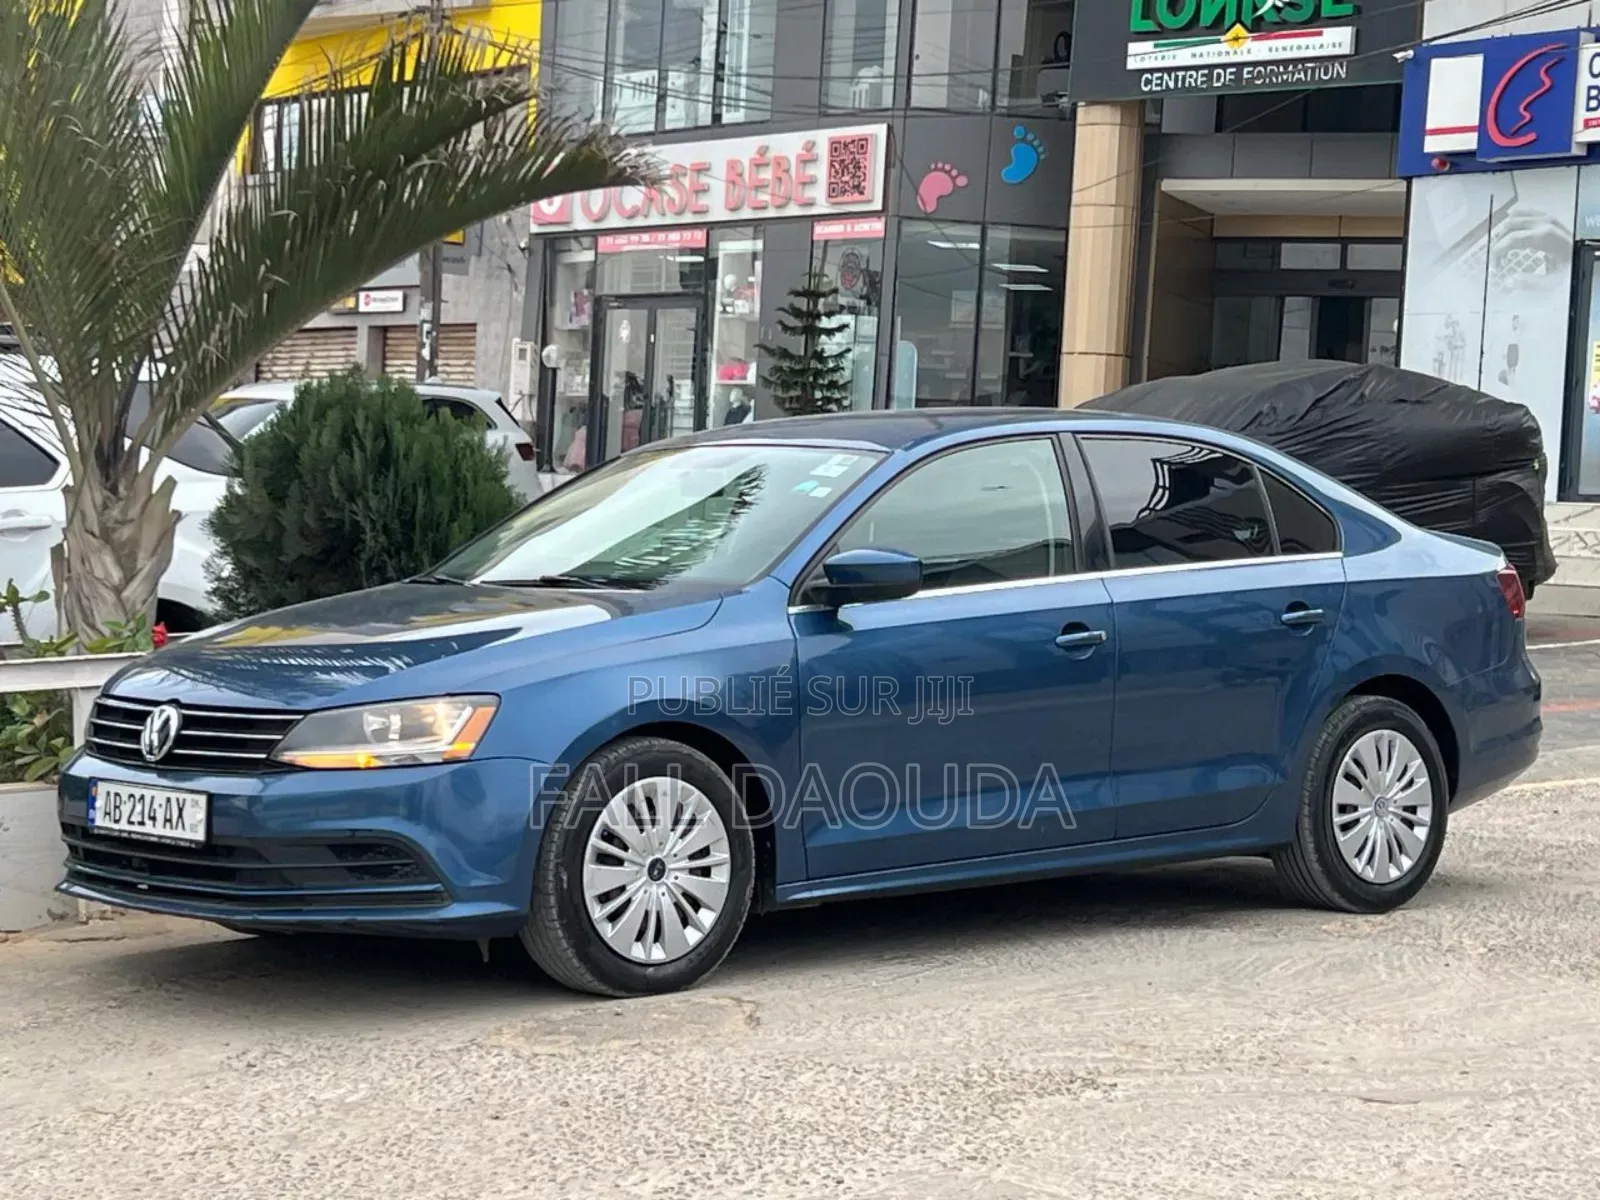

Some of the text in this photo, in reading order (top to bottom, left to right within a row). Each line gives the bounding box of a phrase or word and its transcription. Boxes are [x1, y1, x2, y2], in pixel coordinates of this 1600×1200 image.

[1134, 54, 1177, 62] LOTERIE
[1191, 48, 1252, 59] NATIONALE
[1140, 61, 1348, 92] CENTRE DE FORMATION
[724, 140, 818, 212] BÉBÉ
